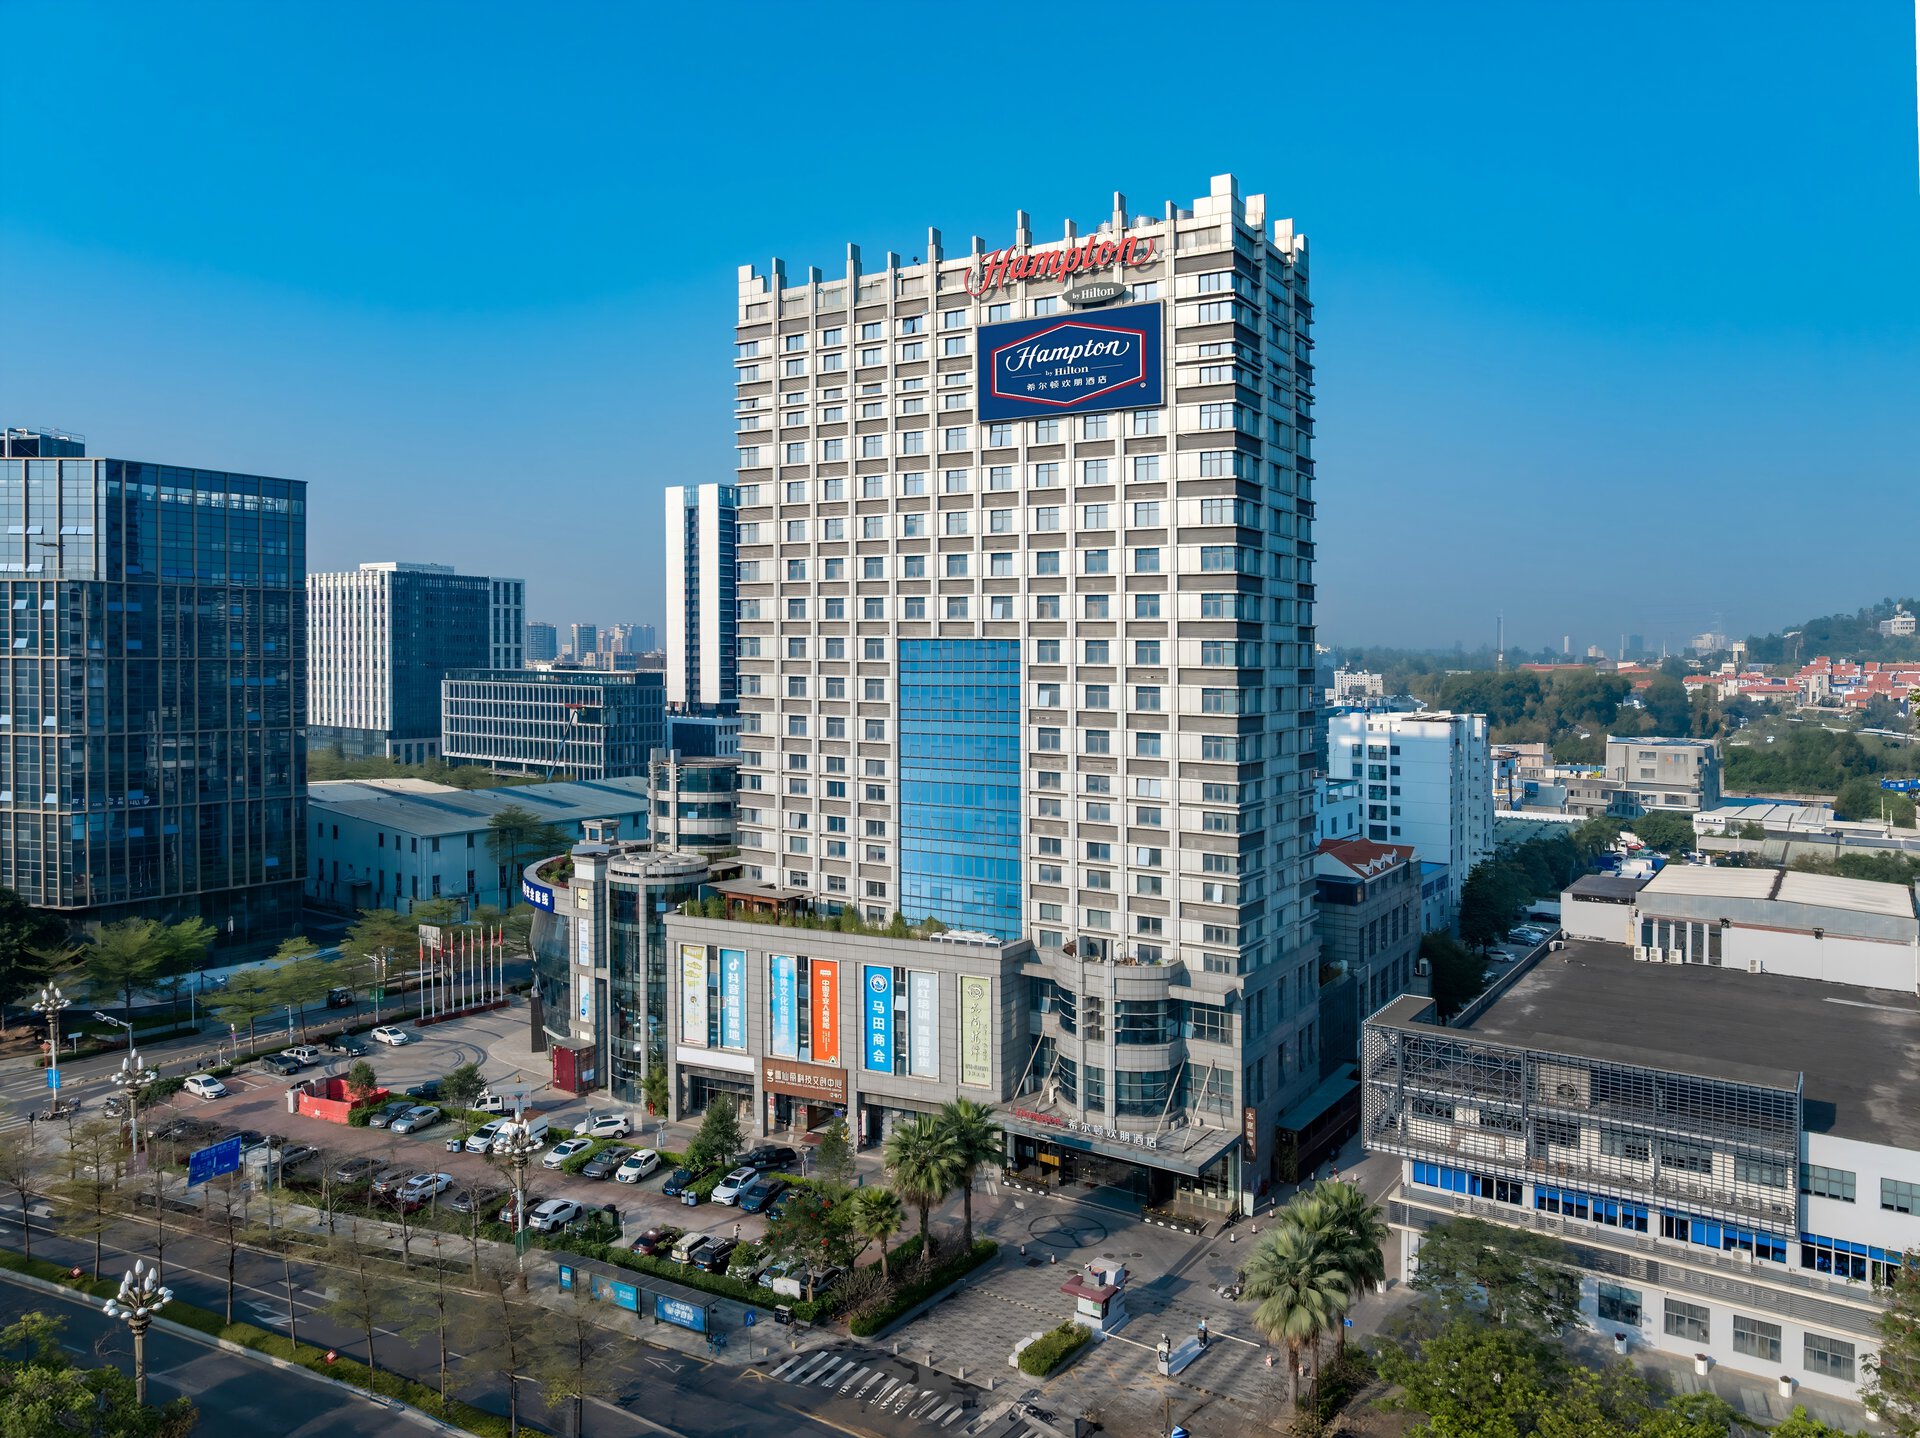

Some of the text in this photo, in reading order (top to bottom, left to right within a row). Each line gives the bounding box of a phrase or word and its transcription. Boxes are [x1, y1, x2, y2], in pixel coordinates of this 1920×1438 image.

[964, 235, 1155, 297] Hampton
[1081, 285, 1115, 299] Hilton
[1005, 339, 1130, 372] Hampton
[1054, 365, 1089, 377] Hilton
[1027, 375, 1107, 392] 希尔顿欢朋酒店
[728, 972, 740, 1041] 抖音直播基地
[872, 1000, 885, 1063] 马田商会
[1069, 1117, 1157, 1148] 希尔顿欢朋酒店
